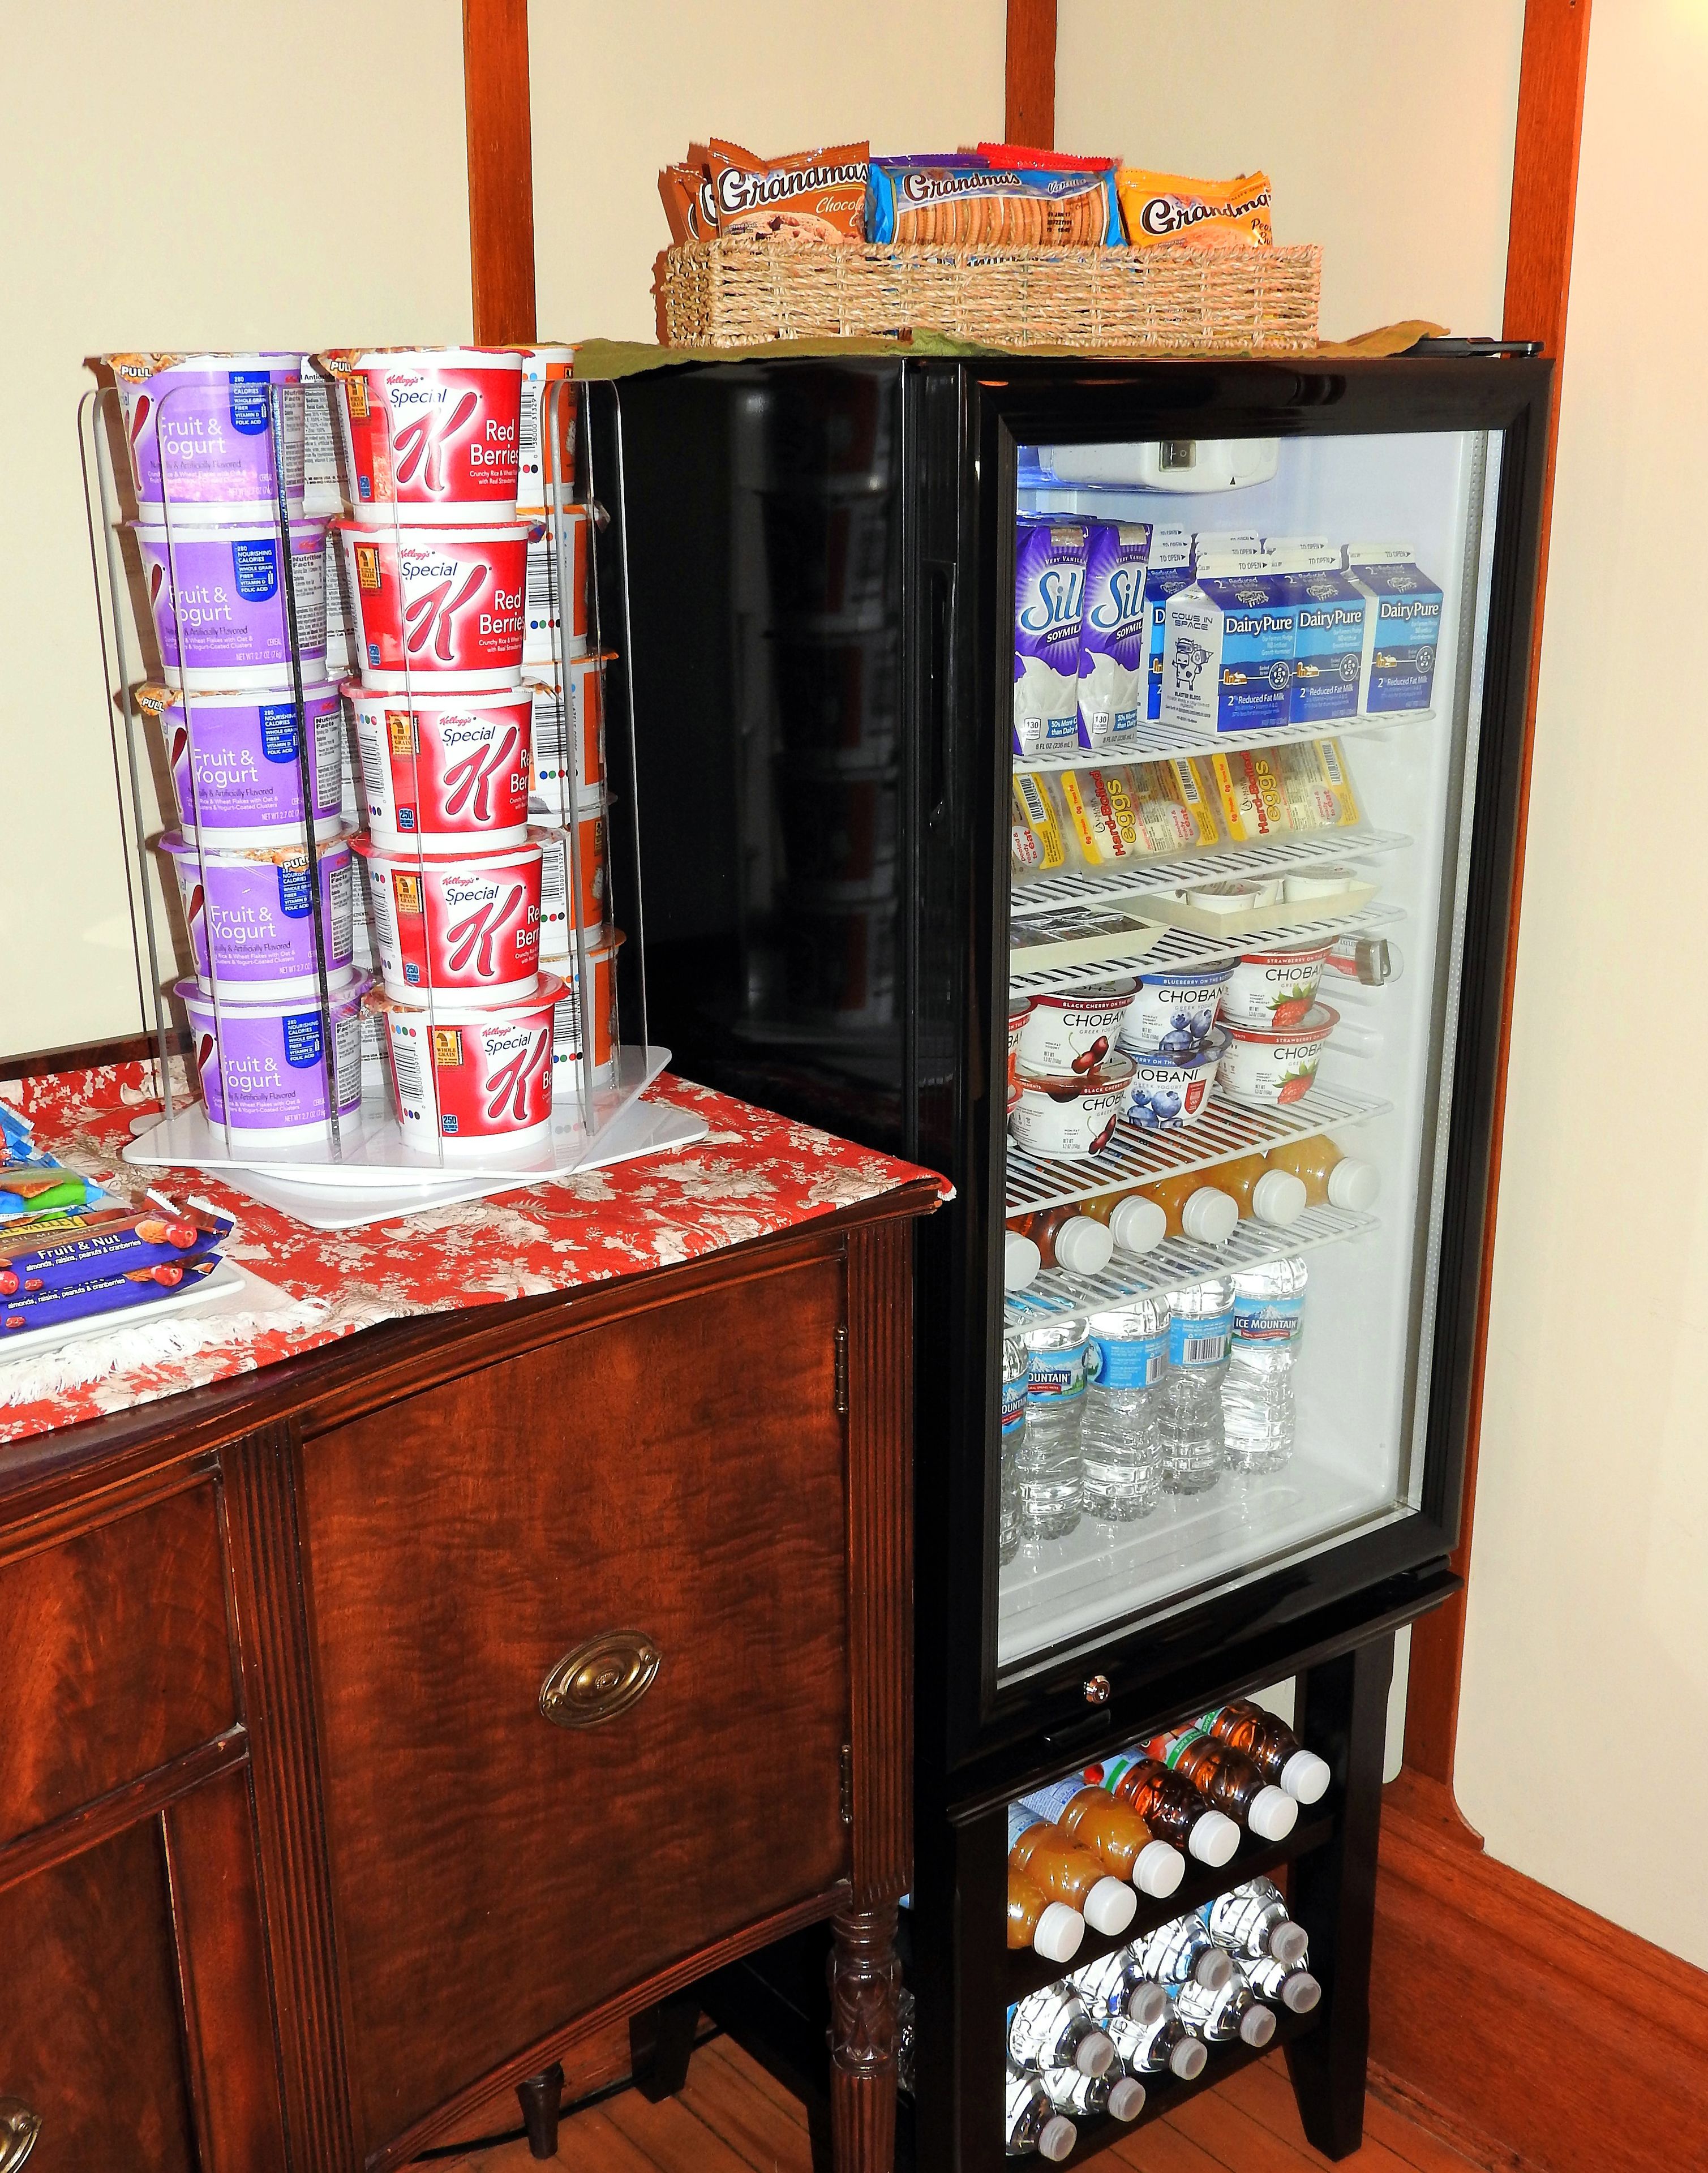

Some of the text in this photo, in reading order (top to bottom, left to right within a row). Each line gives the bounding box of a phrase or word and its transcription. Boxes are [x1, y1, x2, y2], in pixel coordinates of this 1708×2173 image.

[904, 173, 1020, 201] Grandma's
[121, 365, 153, 377] PULL
[331, 362, 351, 372] PULL
[387, 375, 418, 386] Kellogg's
[390, 389, 447, 407] Special
[208, 419, 222, 435] &
[486, 419, 514, 441] Red
[470, 444, 519, 465] Berries
[401, 549, 430, 560] Kellogg's
[402, 562, 457, 580] Special
[214, 587, 228, 603] &
[495, 587, 521, 611] Red
[405, 565, 487, 660] K
[1171, 612, 1200, 622] COWS
[1300, 610, 1362, 629] DairyPure
[1381, 602, 1439, 621] DairyPure
[1116, 621, 1143, 640] SOYMIL
[1175, 620, 1208, 630] SPACE
[1226, 616, 1293, 635] DairyPure
[1310, 687, 1333, 696] Reduced
[1343, 684, 1354, 692] Milk
[1387, 677, 1409, 686] Reduced
[142, 698, 165, 711] PULL
[1238, 695, 1263, 704] Reduced
[440, 715, 471, 725] Kellogg's
[442, 726, 495, 746] Special
[1063, 727, 1075, 735] Dairy
[194, 748, 255, 766] Fruit &
[196, 766, 259, 788] Yogurt
[444, 727, 517, 821] K
[246, 787, 273, 797] Flavored
[1241, 750, 1269, 834] Hard-Boiled
[1256, 760, 1281, 822] eggs
[400, 810, 412, 818] 250
[1089, 770, 1126, 856] Hard-Boiled
[1107, 779, 1136, 843] eggs
[1024, 830, 1035, 849] eat
[442, 877, 474, 886] Kellogg's
[445, 886, 499, 905] Special
[211, 905, 273, 923] Fruit &
[212, 922, 277, 944] Yogurt
[447, 885, 522, 976] K
[264, 942, 290, 951] Flavored
[406, 965, 418, 974] 250
[1265, 964, 1323, 981] CHOBA
[1158, 987, 1224, 1003] CHOBAN
[288, 1020, 319, 1029] NOURISHING
[1063, 1010, 1126, 1027] CHOBAN
[482, 1027, 511, 1037] Kellogg's
[485, 1032, 531, 1055] Special
[1274, 1043, 1322, 1060] CHOBA
[225, 1055, 278, 1072] ruit &
[226, 1071, 282, 1092] ogurt
[486, 1029, 547, 1120] K
[1137, 1069, 1198, 1082] OBANI
[270, 1091, 295, 1100] Flavored
[37, 1234, 121, 1260] Fruit & Nut
[25, 1260, 54, 1272] almonds,
[55, 1255, 78, 1264] raisins,
[79, 1249, 102, 1260] peanuts
[109, 1240, 141, 1252] cranberries
[7, 1298, 37, 1309] almonds,
[38, 1292, 61, 1303] raisins,
[61, 1286, 85, 1298] peanuts
[93, 1278, 126, 1290] cranberries
[1236, 1319, 1297, 1329] ICE MOUNTAIN
[1028, 1373, 1068, 1382] OUNTAIN
[1174, 1738, 1188, 1753] JUICE
